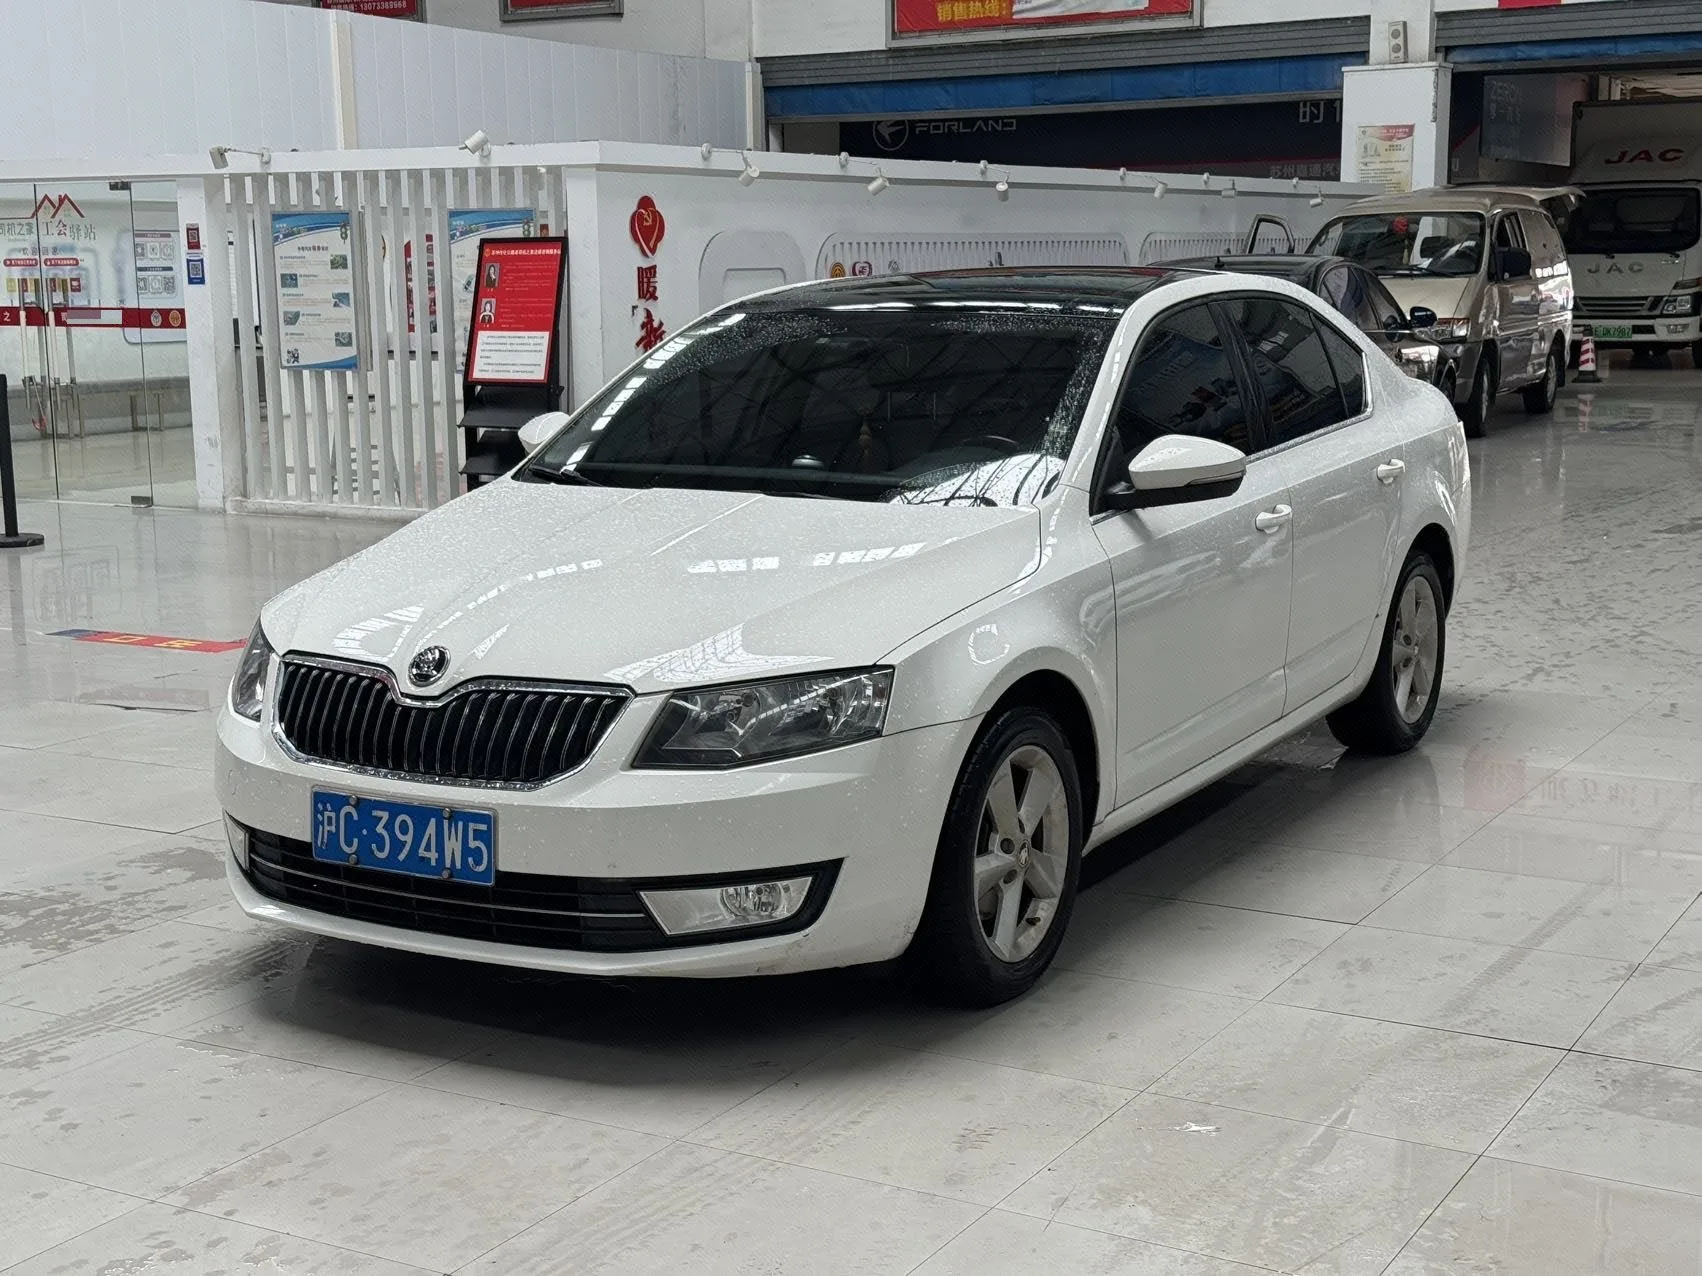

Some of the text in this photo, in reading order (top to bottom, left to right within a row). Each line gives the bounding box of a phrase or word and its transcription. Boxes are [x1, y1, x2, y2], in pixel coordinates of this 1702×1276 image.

[914, 119, 1017, 135] FORLAND
[1604, 149, 1685, 164] JAC
[42, 219, 96, 241] 工会驿站
[1587, 261, 1644, 274] JAC
